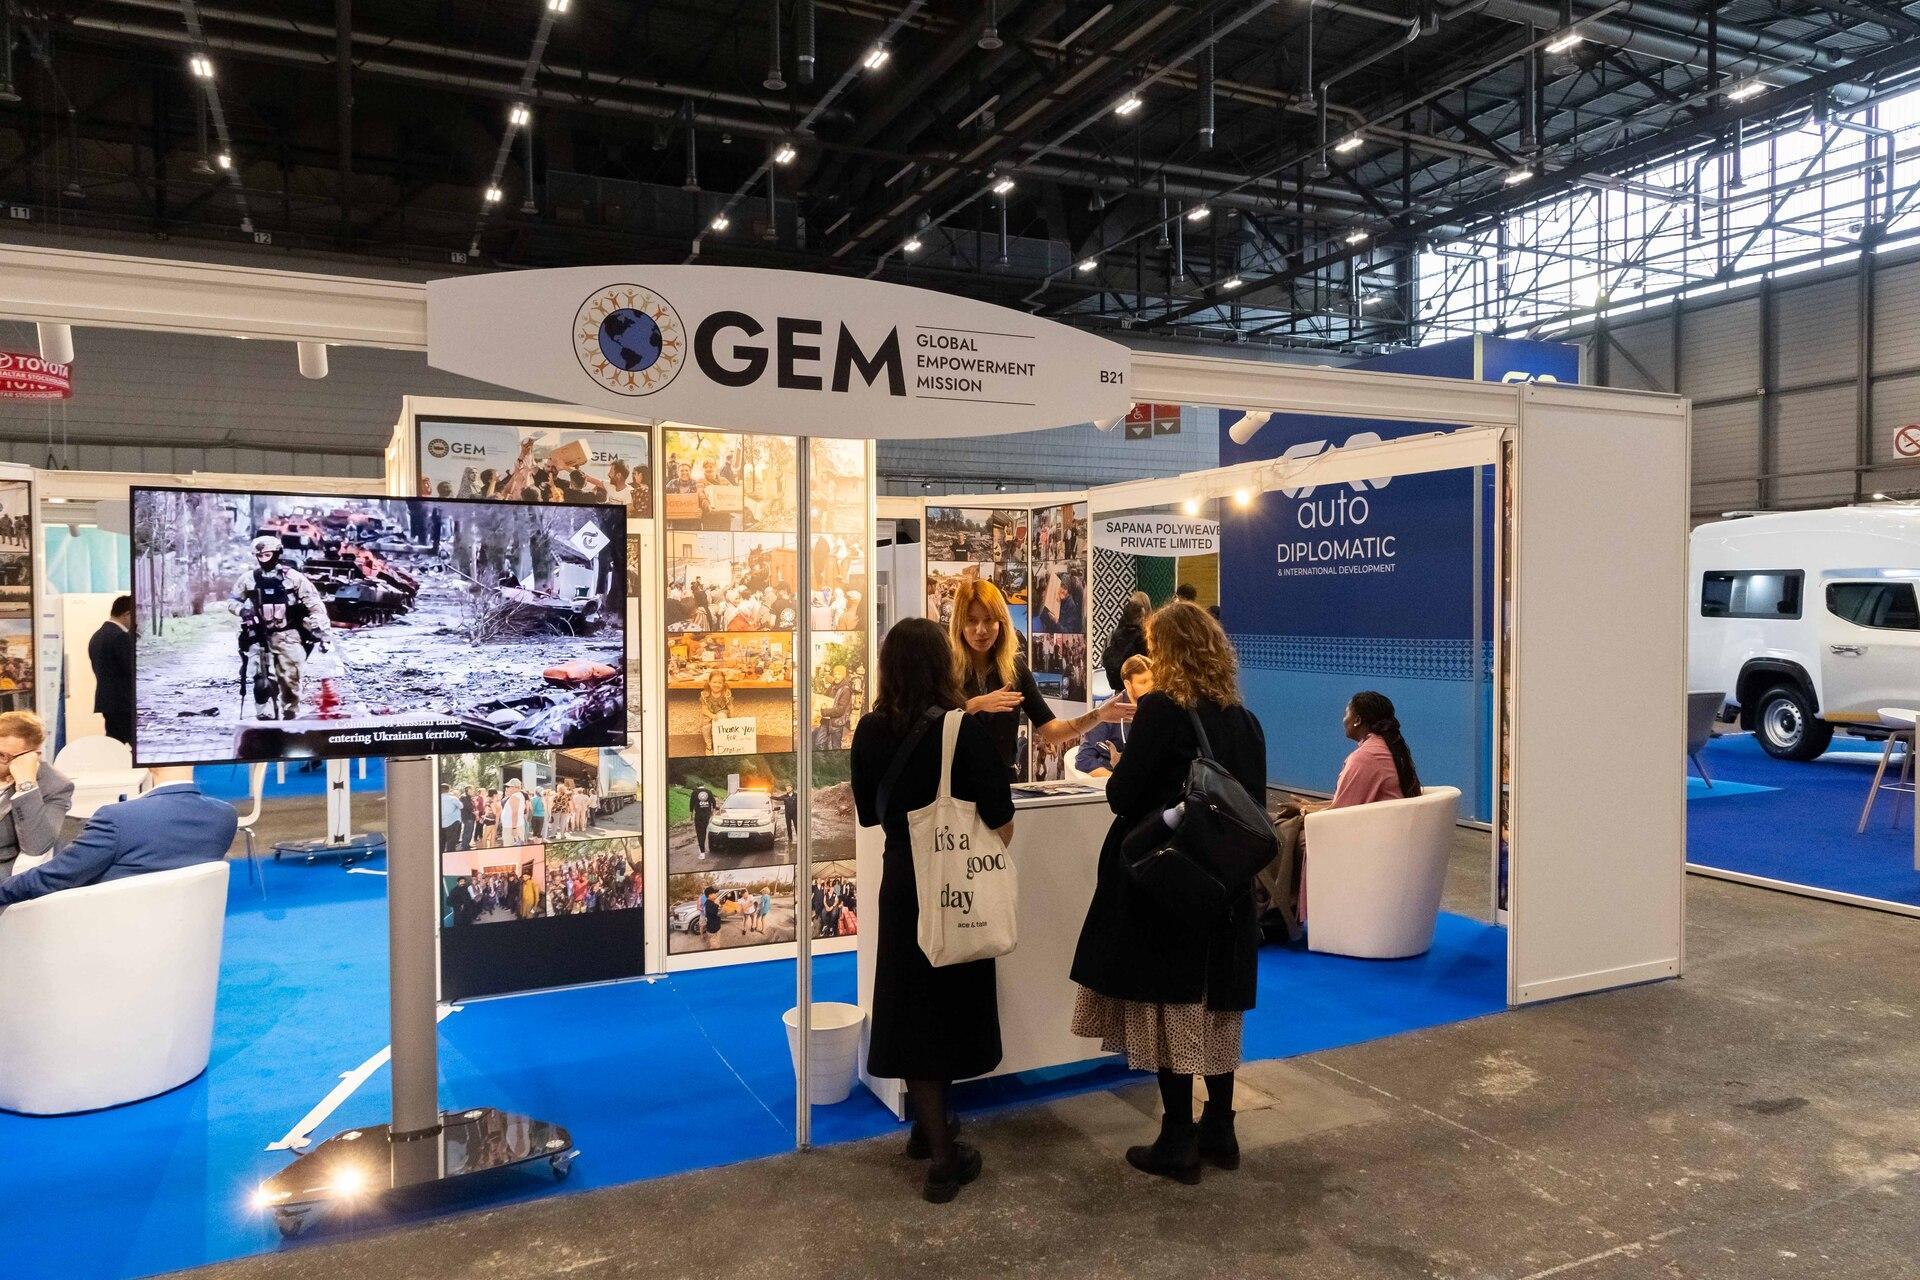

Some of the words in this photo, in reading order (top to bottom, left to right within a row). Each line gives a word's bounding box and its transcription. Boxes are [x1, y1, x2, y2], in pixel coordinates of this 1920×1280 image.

[12, 207, 28, 218] 11
[255, 232, 270, 244] 12
[452, 252, 465, 263] 13
[916, 334, 978, 352] GLOBAL
[694, 311, 906, 396] GEM
[15, 356, 69, 378] TOYOTA
[917, 355, 1035, 376] EMPOWERMENT
[917, 376, 982, 392] MISSION
[1100, 371, 1123, 384] B21
[451, 442, 486, 456] GEM
[590, 451, 619, 462] GEM
[1297, 489, 1369, 529] auto
[1106, 522, 1153, 534] SAPANA
[1121, 537, 1166, 548] PRIVATE
[1170, 539, 1212, 549] LIMITED
[1277, 536, 1396, 562] DIPLOMATIC
[1277, 568, 1283, 576] &
[1284, 566, 1337, 576] INTERNATIONAL
[1339, 564, 1396, 574] DEVELOPMENT
[396, 717, 433, 727] Russian
[436, 715, 462, 726] tanks
[329, 733, 372, 744] entering
[373, 731, 423, 742] Ukrainian
[425, 729, 468, 741] territory,
[959, 833, 970, 850] a
[966, 848, 1006, 880] good
[940, 883, 974, 914] day
